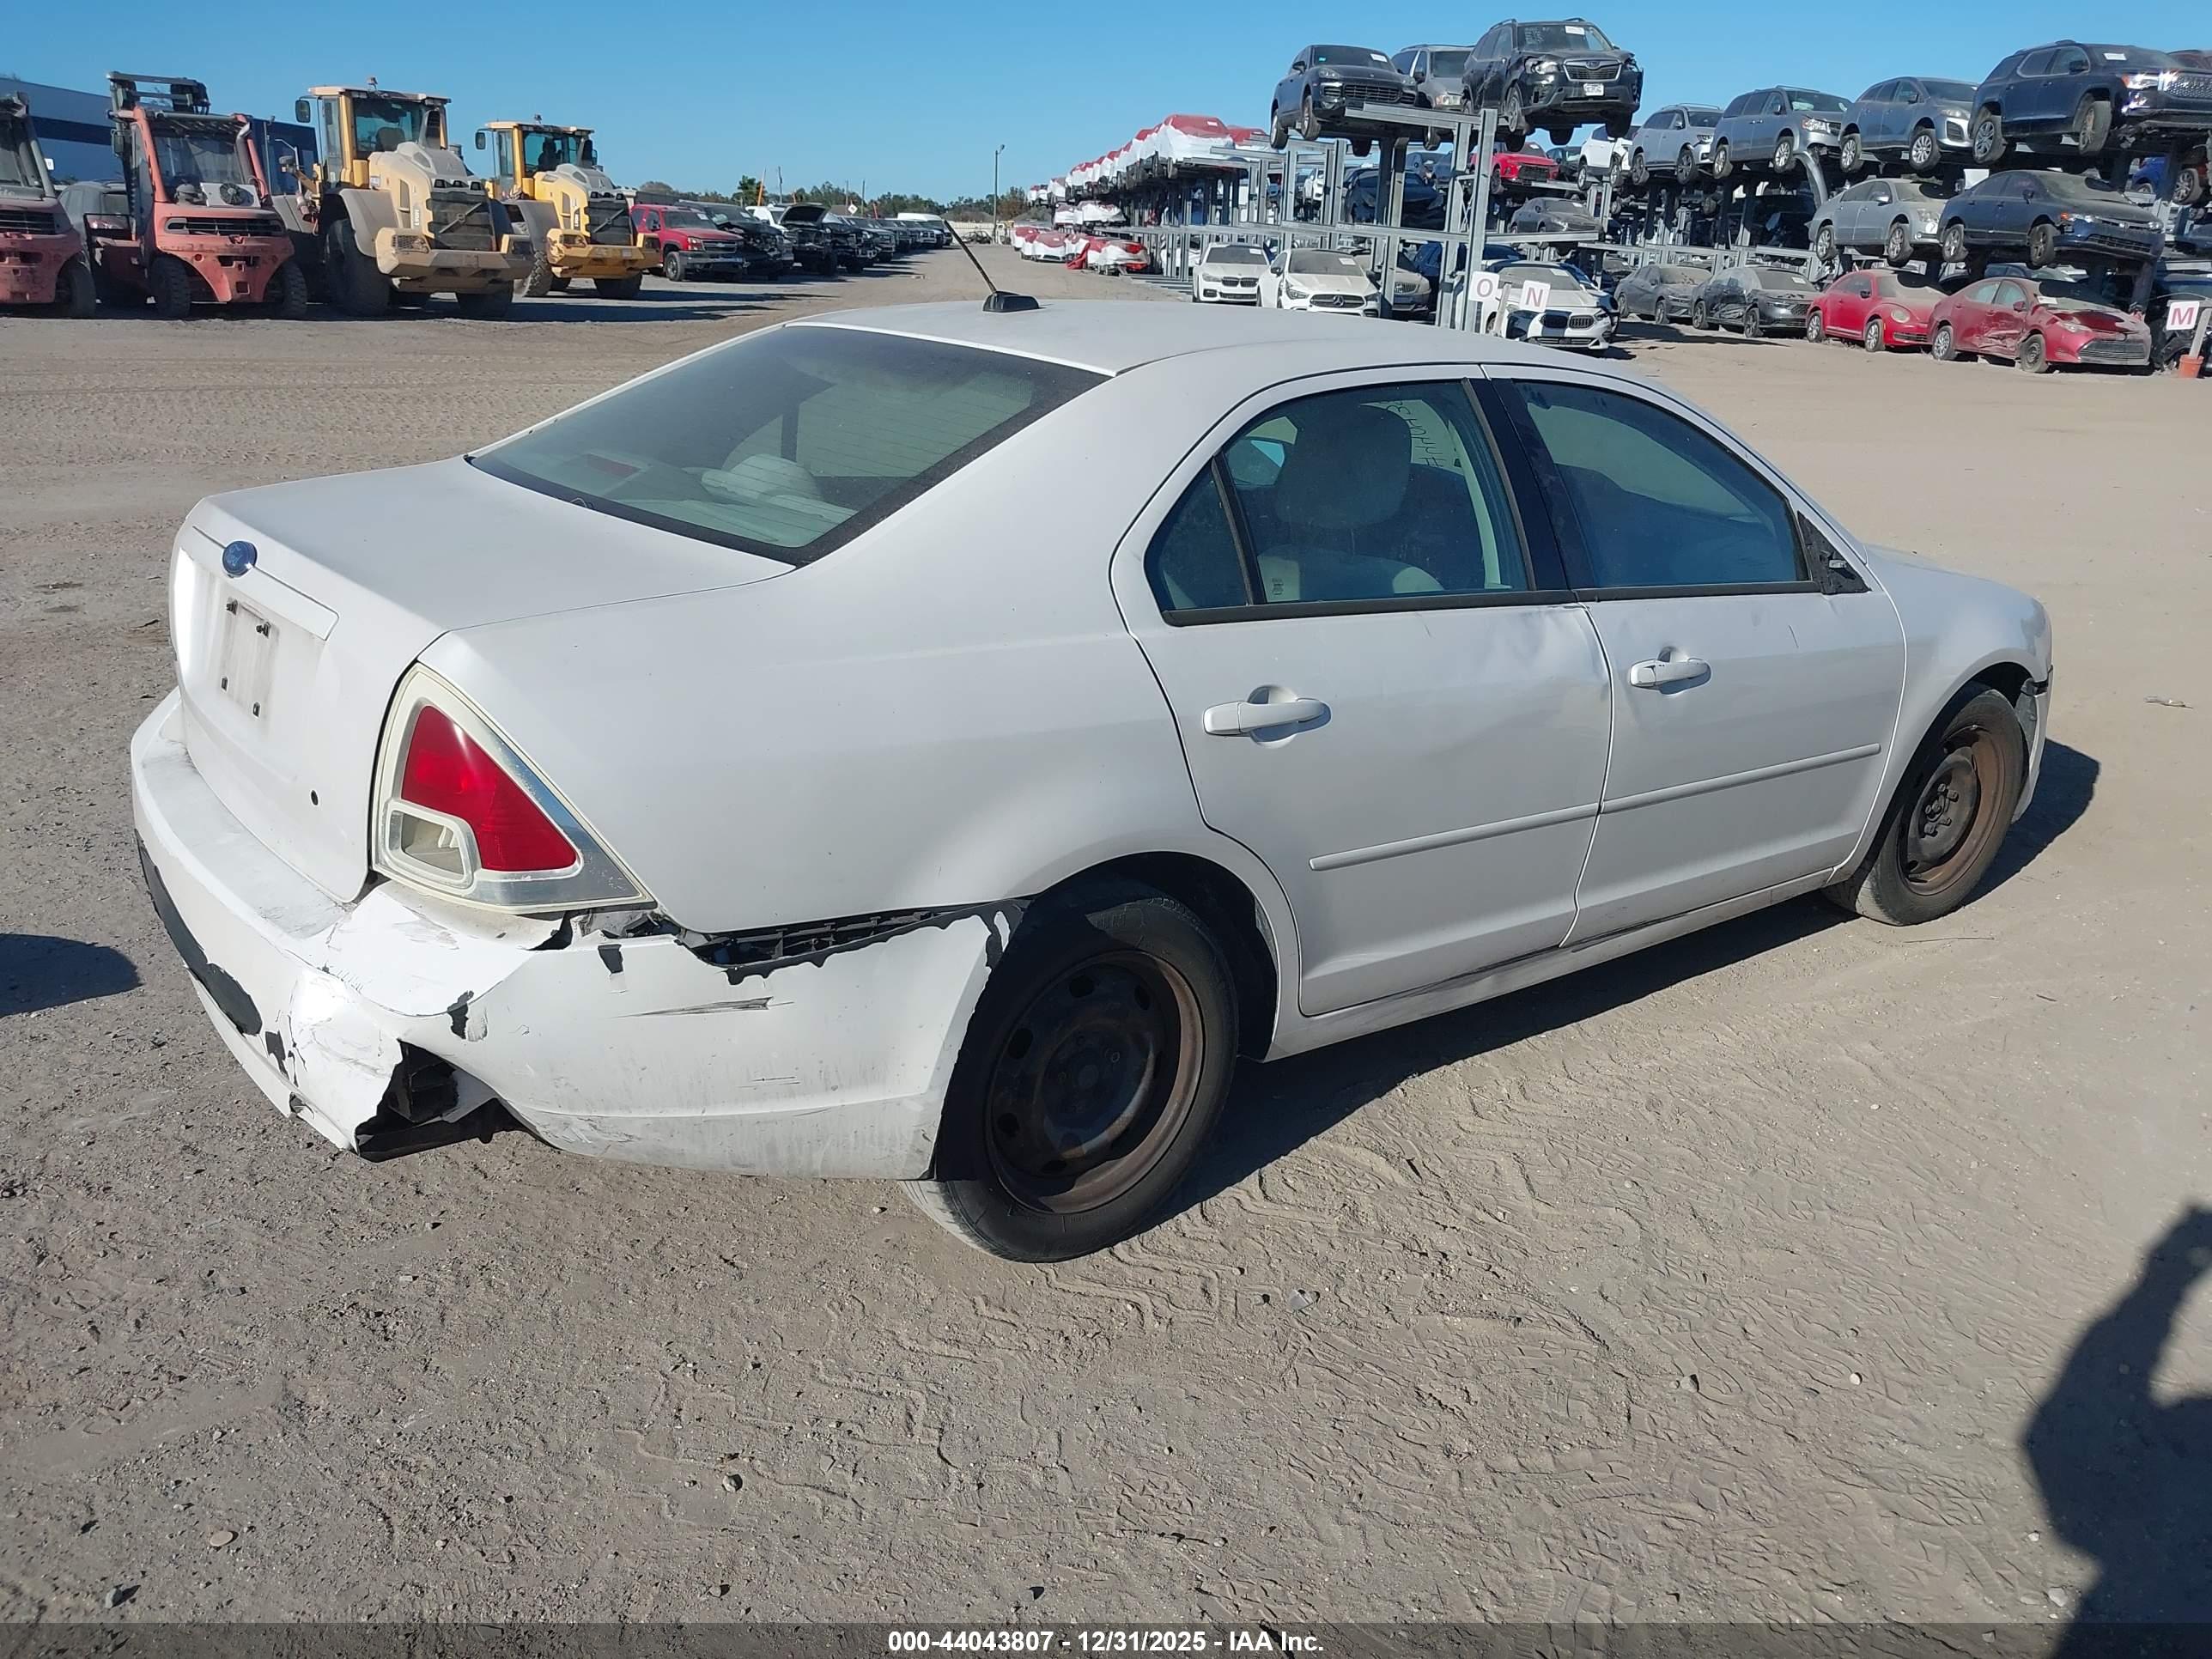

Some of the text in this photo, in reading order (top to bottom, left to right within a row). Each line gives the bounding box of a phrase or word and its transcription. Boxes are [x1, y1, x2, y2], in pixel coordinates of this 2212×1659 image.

[1477, 278, 1493, 297] O
[1526, 287, 1543, 307] N
[2171, 307, 2195, 325] M
